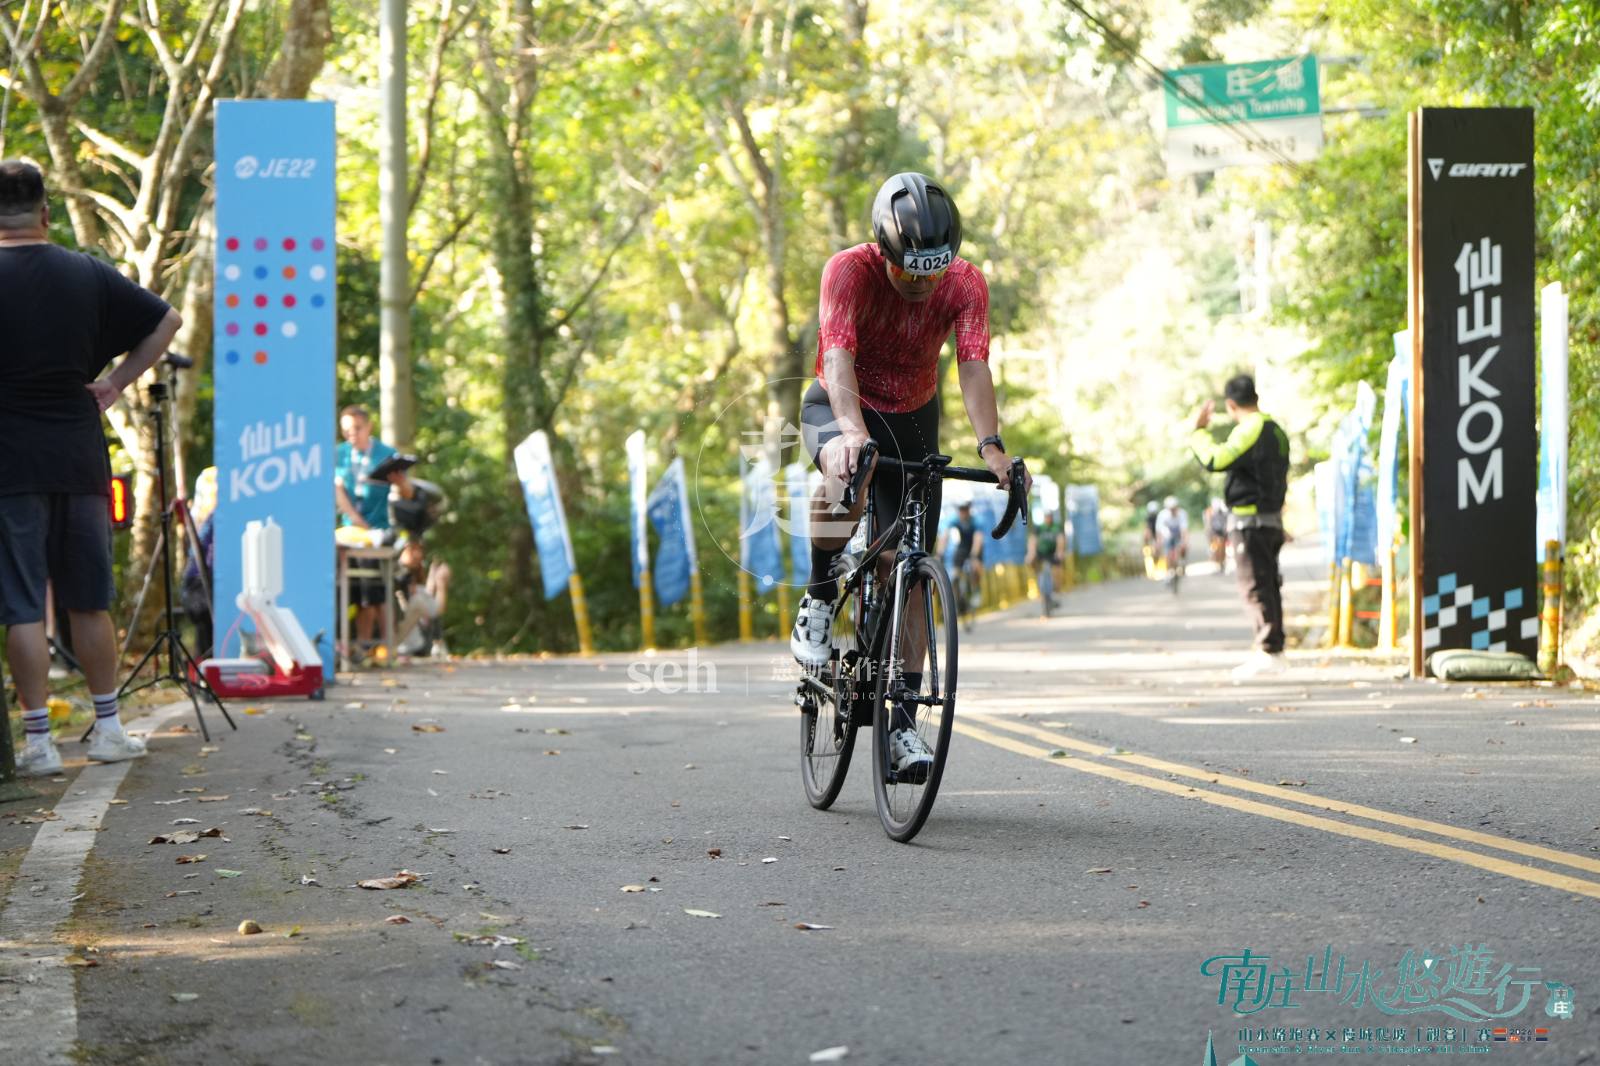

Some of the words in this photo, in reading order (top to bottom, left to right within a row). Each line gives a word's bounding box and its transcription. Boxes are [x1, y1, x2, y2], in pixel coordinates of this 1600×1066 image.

[258, 158, 317, 178] JE22
[1448, 162, 1527, 177] GIANT
[909, 253, 950, 271] 4024
[239, 411, 306, 463] 仙山
[229, 443, 322, 502] KOM
